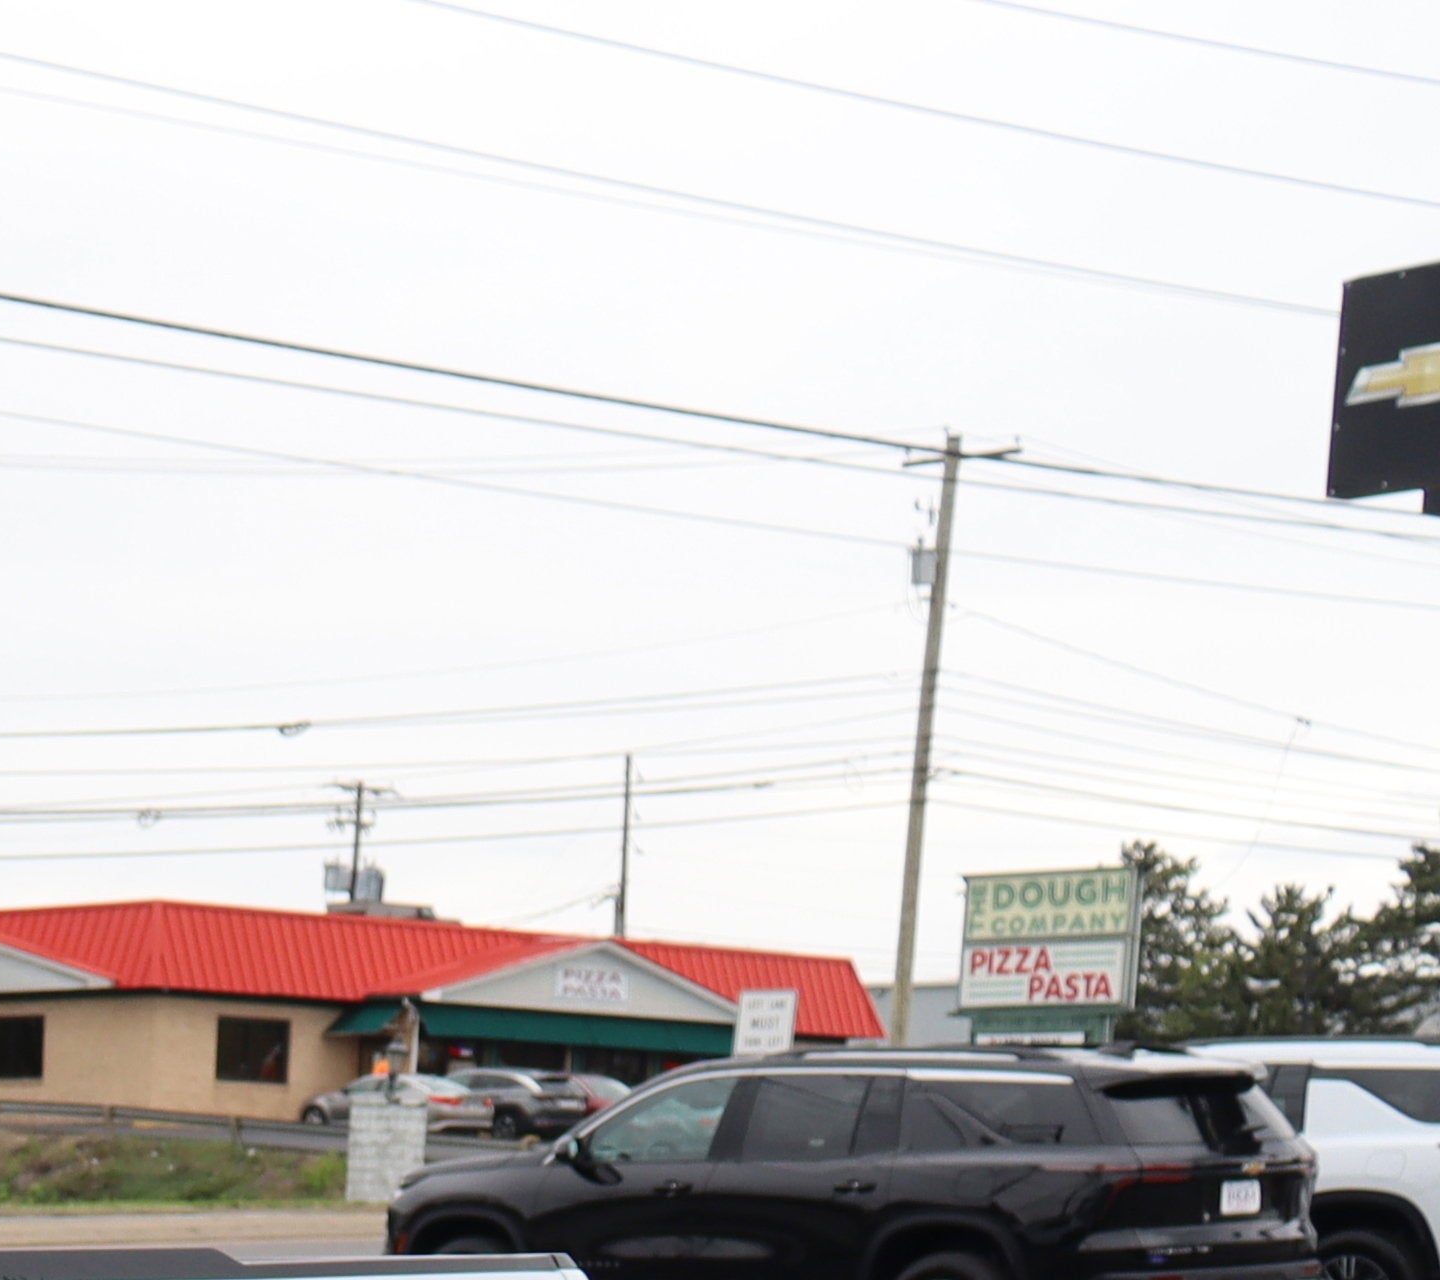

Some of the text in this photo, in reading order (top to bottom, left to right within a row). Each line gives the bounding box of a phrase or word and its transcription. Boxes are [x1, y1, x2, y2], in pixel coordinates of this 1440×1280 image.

[969, 876, 1127, 935] THE DOUGH
[990, 912, 1126, 936] COMPANY
[970, 946, 1052, 975] PIZZA
[1028, 972, 1112, 1001] PASTA
